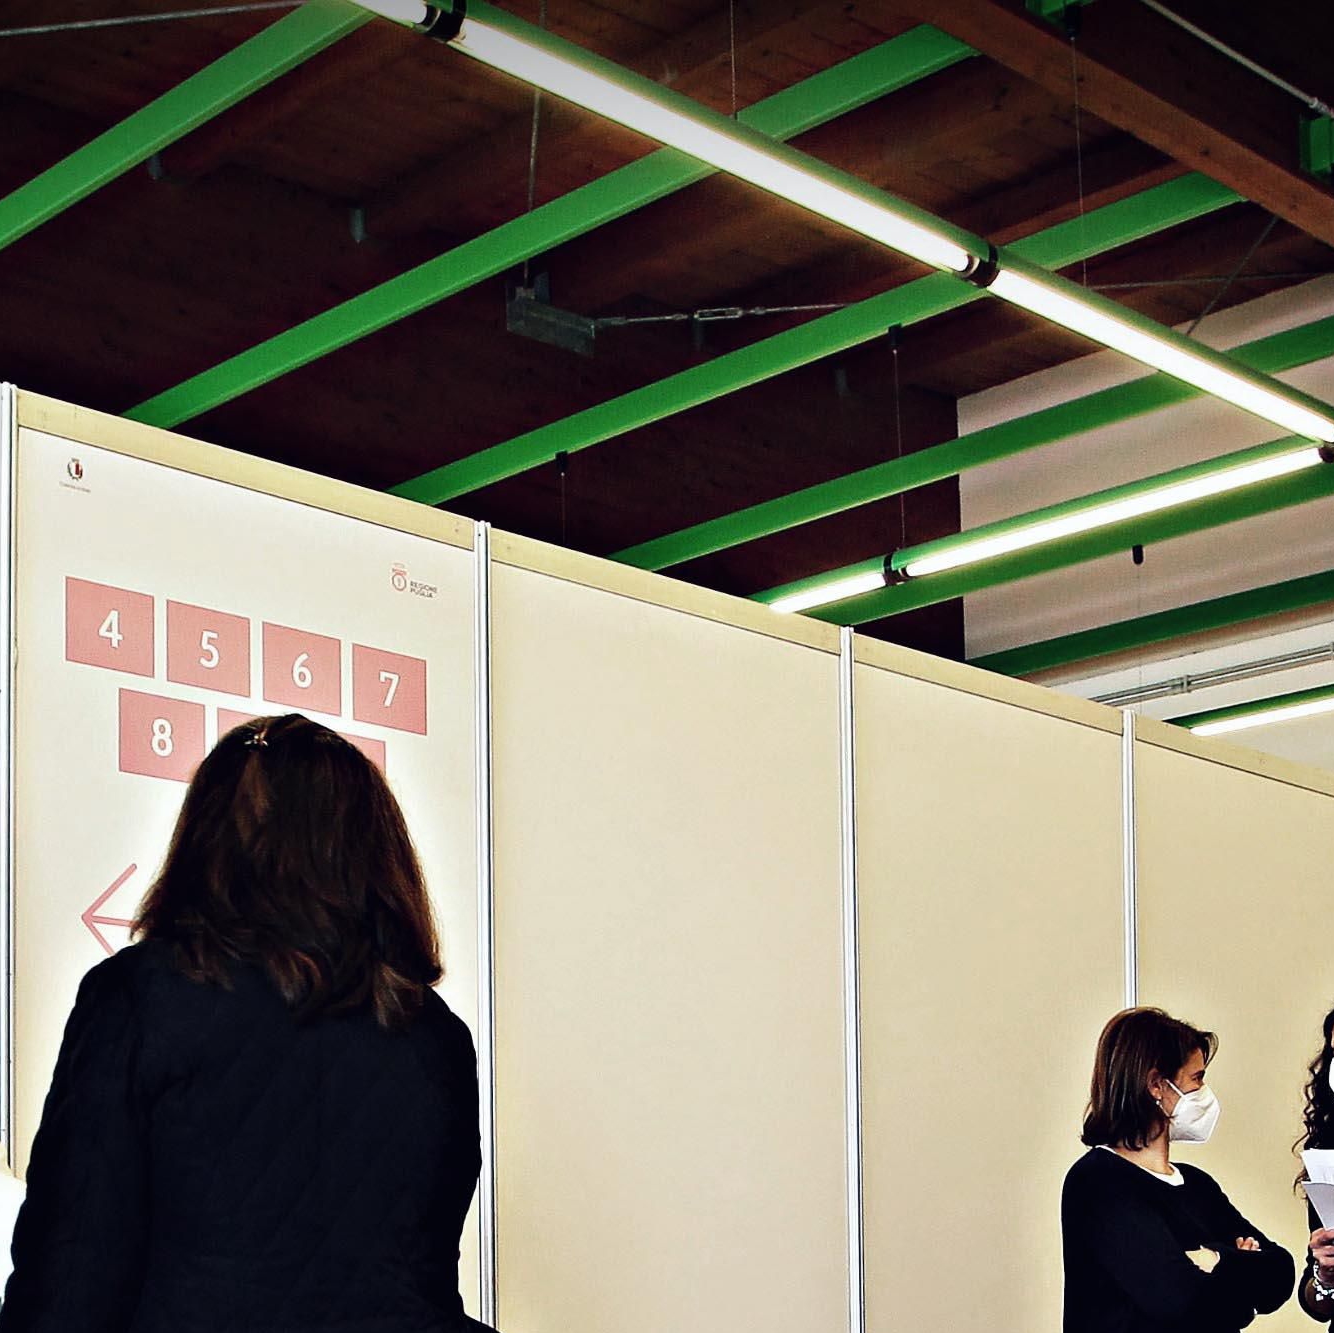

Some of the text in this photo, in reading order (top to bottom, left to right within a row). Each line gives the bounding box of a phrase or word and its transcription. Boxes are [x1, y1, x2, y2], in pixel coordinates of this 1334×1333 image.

[98, 609, 400, 707] 4 5 6 7
[151, 717, 174, 757] 8
